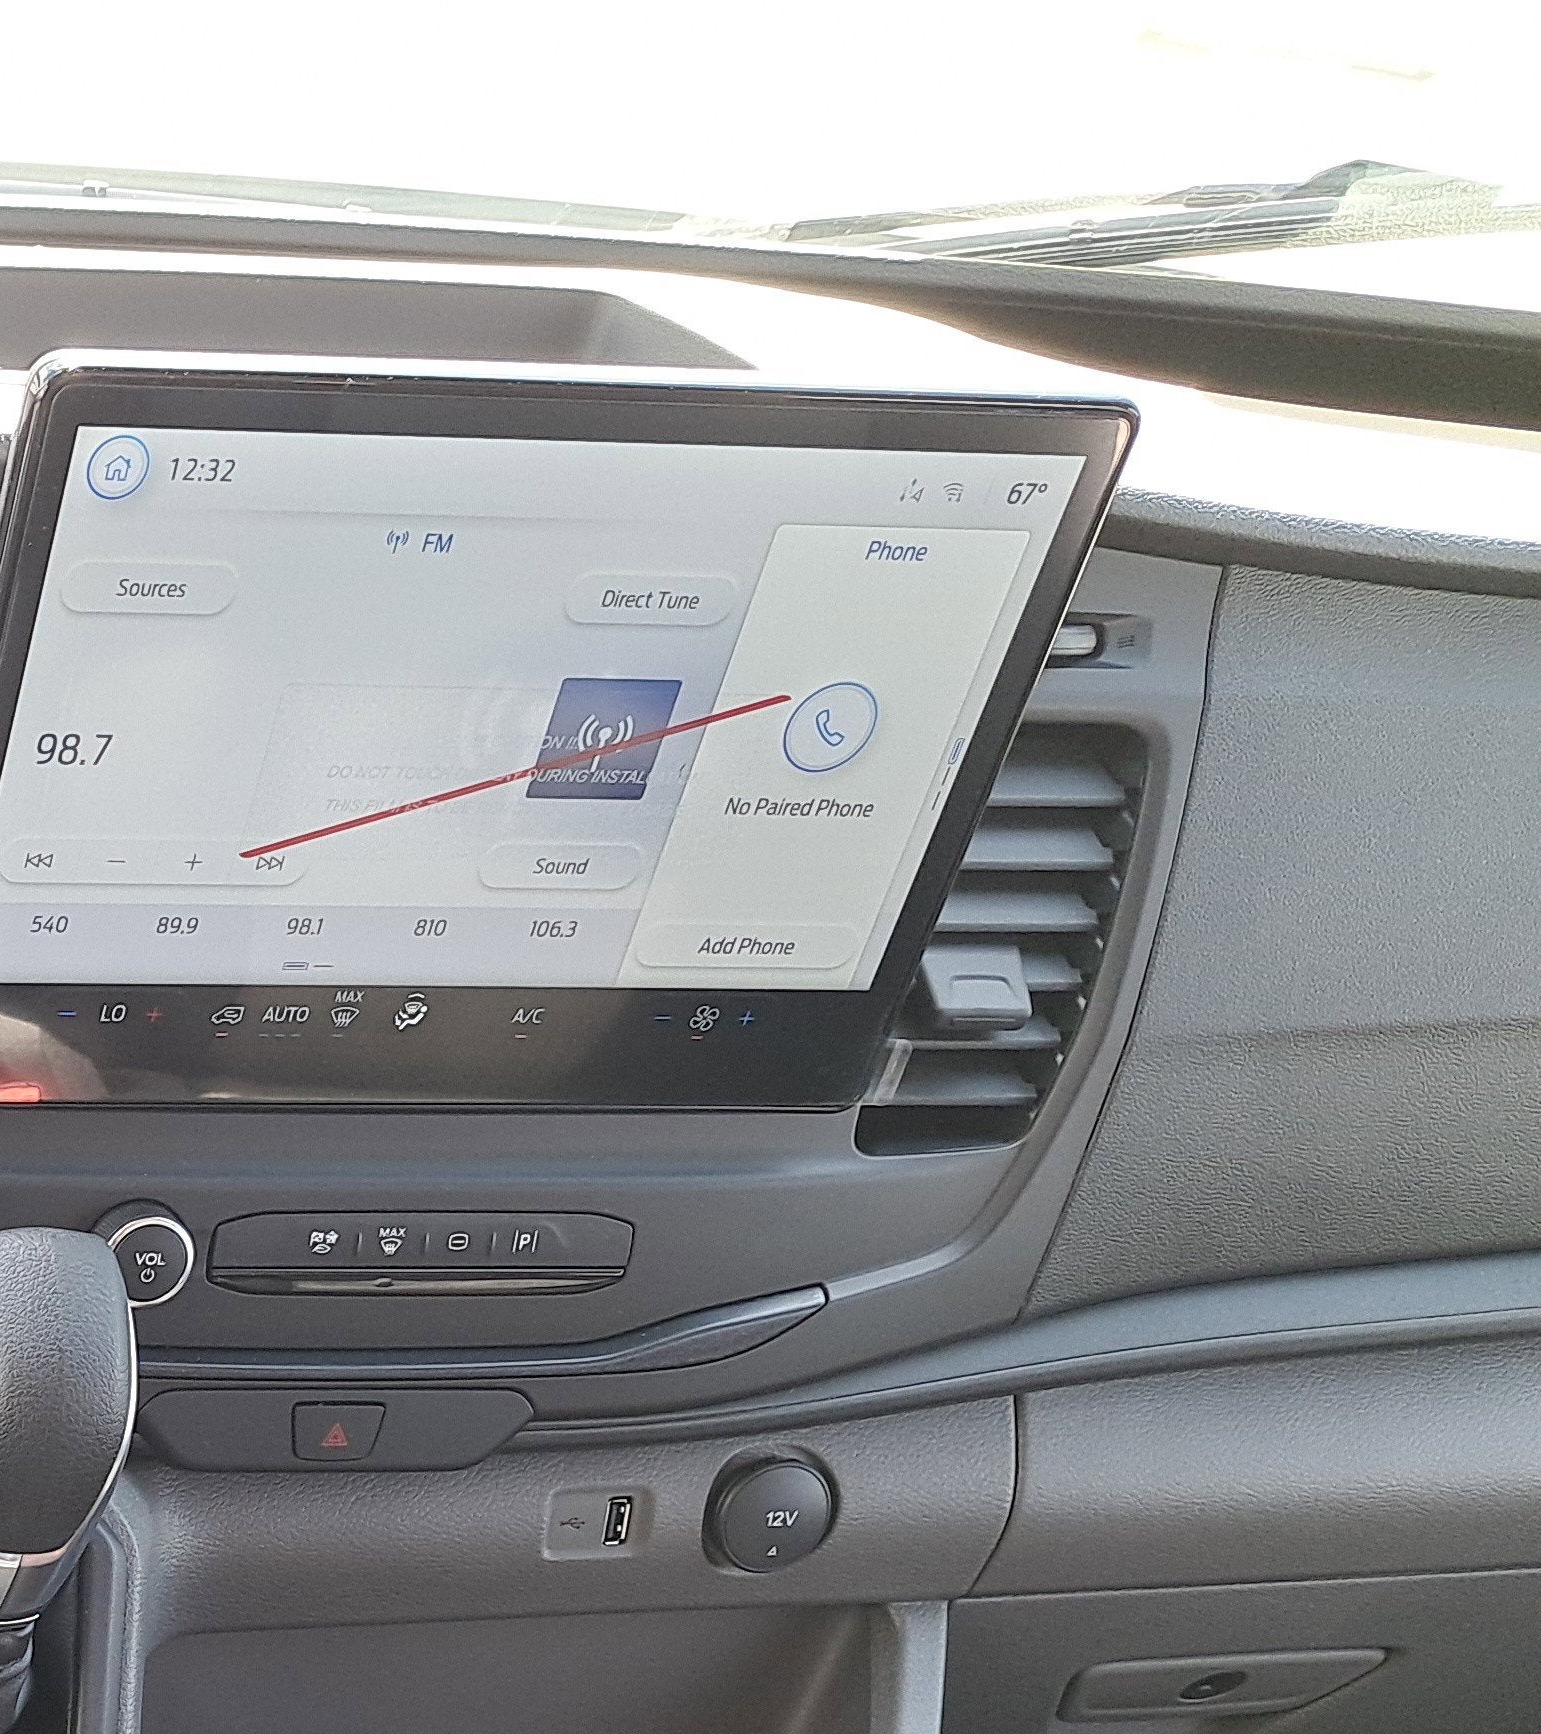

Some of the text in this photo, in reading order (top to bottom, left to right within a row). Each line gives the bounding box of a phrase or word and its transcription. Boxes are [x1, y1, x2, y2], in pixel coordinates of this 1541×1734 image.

[171, 457, 236, 483] 12:32
[1006, 482, 1048, 505] 67°
[421, 532, 454, 553] FM
[864, 540, 928, 562] Phone
[115, 578, 187, 598] Sources
[601, 589, 700, 611] Direct Tune
[36, 733, 114, 766] 98.7
[724, 797, 875, 819] No Paired Phone
[532, 857, 590, 875] Sound
[30, 915, 69, 934] 540
[156, 916, 199, 935] 89.9
[286, 917, 324, 936] 98.1
[413, 918, 448, 937] 810
[529, 920, 579, 938] 106.3
[697, 936, 796, 956] Add Phone
[334, 990, 365, 1003] MAX
[100, 1004, 127, 1022] LO
[262, 1006, 310, 1023] AUTO
[511, 1007, 545, 1025] A/C
[379, 1227, 406, 1238] MAX
[135, 1252, 166, 1267] VOL
[766, 1510, 799, 1529] 12V
